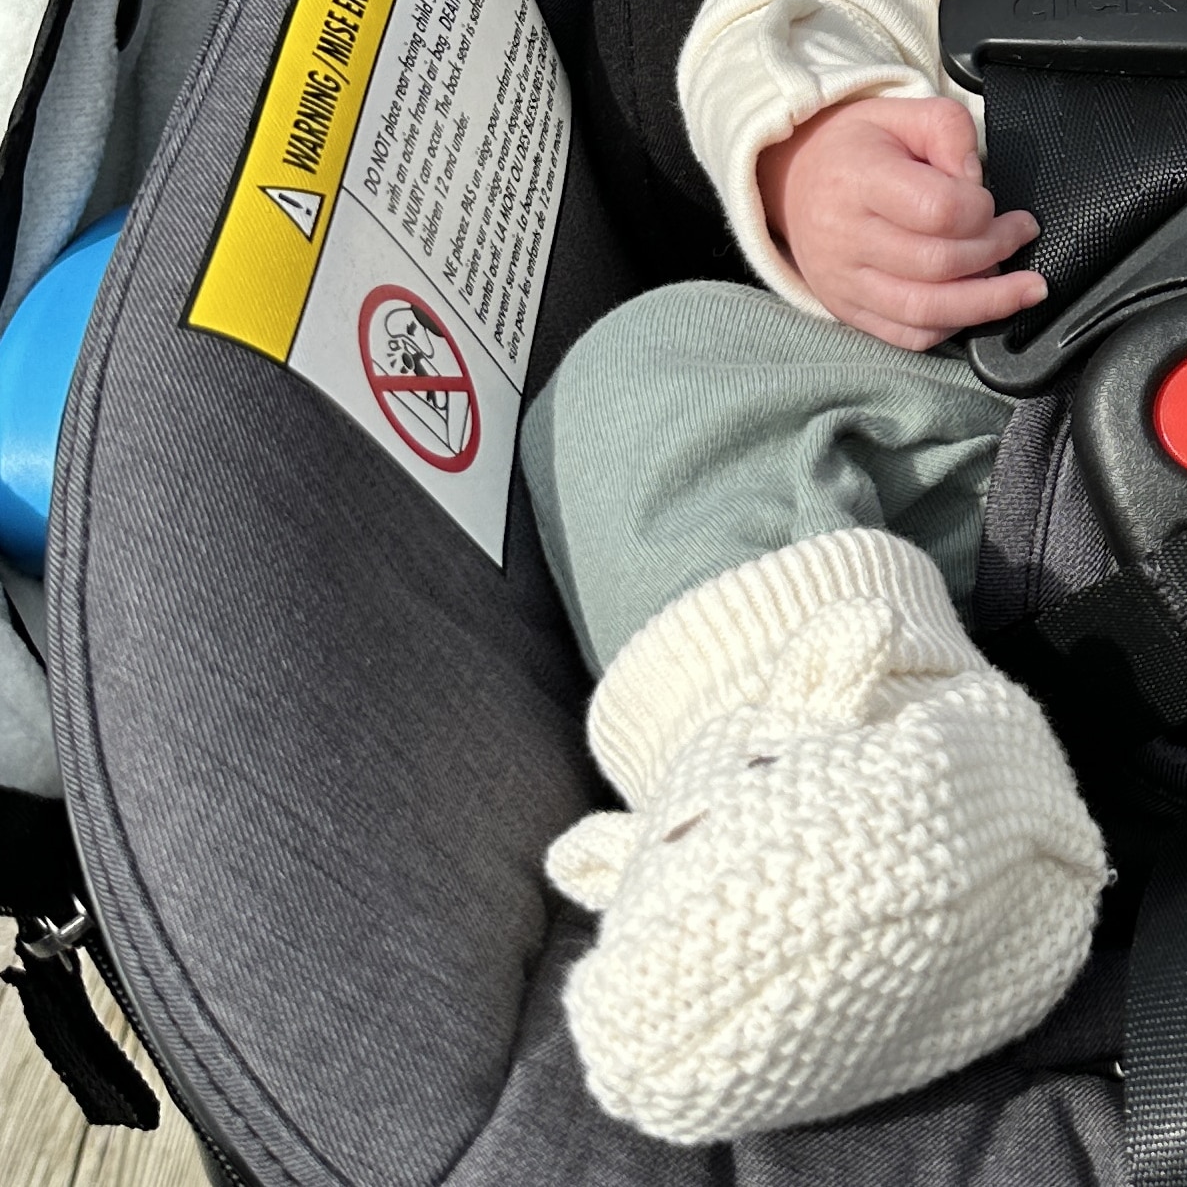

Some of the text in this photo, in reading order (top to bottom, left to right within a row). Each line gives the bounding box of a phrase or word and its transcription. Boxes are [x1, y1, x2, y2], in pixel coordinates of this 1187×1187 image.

[427, 33, 452, 63] bag.
[456, 32, 472, 65] seat
[461, 22, 476, 38] is
[503, 20, 523, 67] faisant
[394, 31, 427, 103] rear-facing
[423, 58, 440, 82] air
[441, 59, 463, 96] back
[496, 61, 513, 106] enfant
[515, 63, 531, 94] d'un
[282, 70, 342, 175] WARNING
[316, 10, 360, 67] MISE
[407, 73, 434, 125] frontal
[434, 94, 453, 120] The
[522, 64, 545, 136] BLESSURES
[380, 100, 402, 143] place
[487, 101, 501, 141] pour
[504, 87, 524, 136] équipé
[401, 123, 420, 165] active
[427, 119, 445, 159] occur.
[515, 128, 531, 162] DES
[537, 110, 552, 154] arrière
[370, 130, 392, 172] NOT
[475, 134, 493, 171] siège
[497, 130, 513, 172] avant
[510, 153, 524, 184] OU
[550, 150, 558, 169] et
[363, 166, 382, 197] DO
[396, 162, 409, 185] an
[419, 157, 434, 185] can
[419, 111, 471, 257] children 12 and under.
[471, 168, 483, 190] un
[487, 170, 503, 208] siège
[518, 151, 543, 216] banquette
[545, 166, 556, 193] ans
[386, 181, 403, 215] with
[401, 178, 426, 238] INJURY
[460, 183, 477, 218] PAS
[481, 205, 493, 226] un
[498, 176, 518, 226] MORT
[538, 186, 551, 210] 12
[476, 224, 487, 250] sur
[493, 220, 508, 244] LA
[515, 212, 529, 234] La
[533, 210, 546, 231] de
[449, 215, 470, 266] placez
[525, 228, 542, 278] enfants
[442, 255, 459, 286] NE
[457, 247, 482, 306] l'arrière
[517, 276, 532, 299] les
[473, 270, 495, 326] frontal
[514, 295, 527, 338] pour
[493, 285, 512, 350] peuvent
[506, 330, 521, 364] sûre
